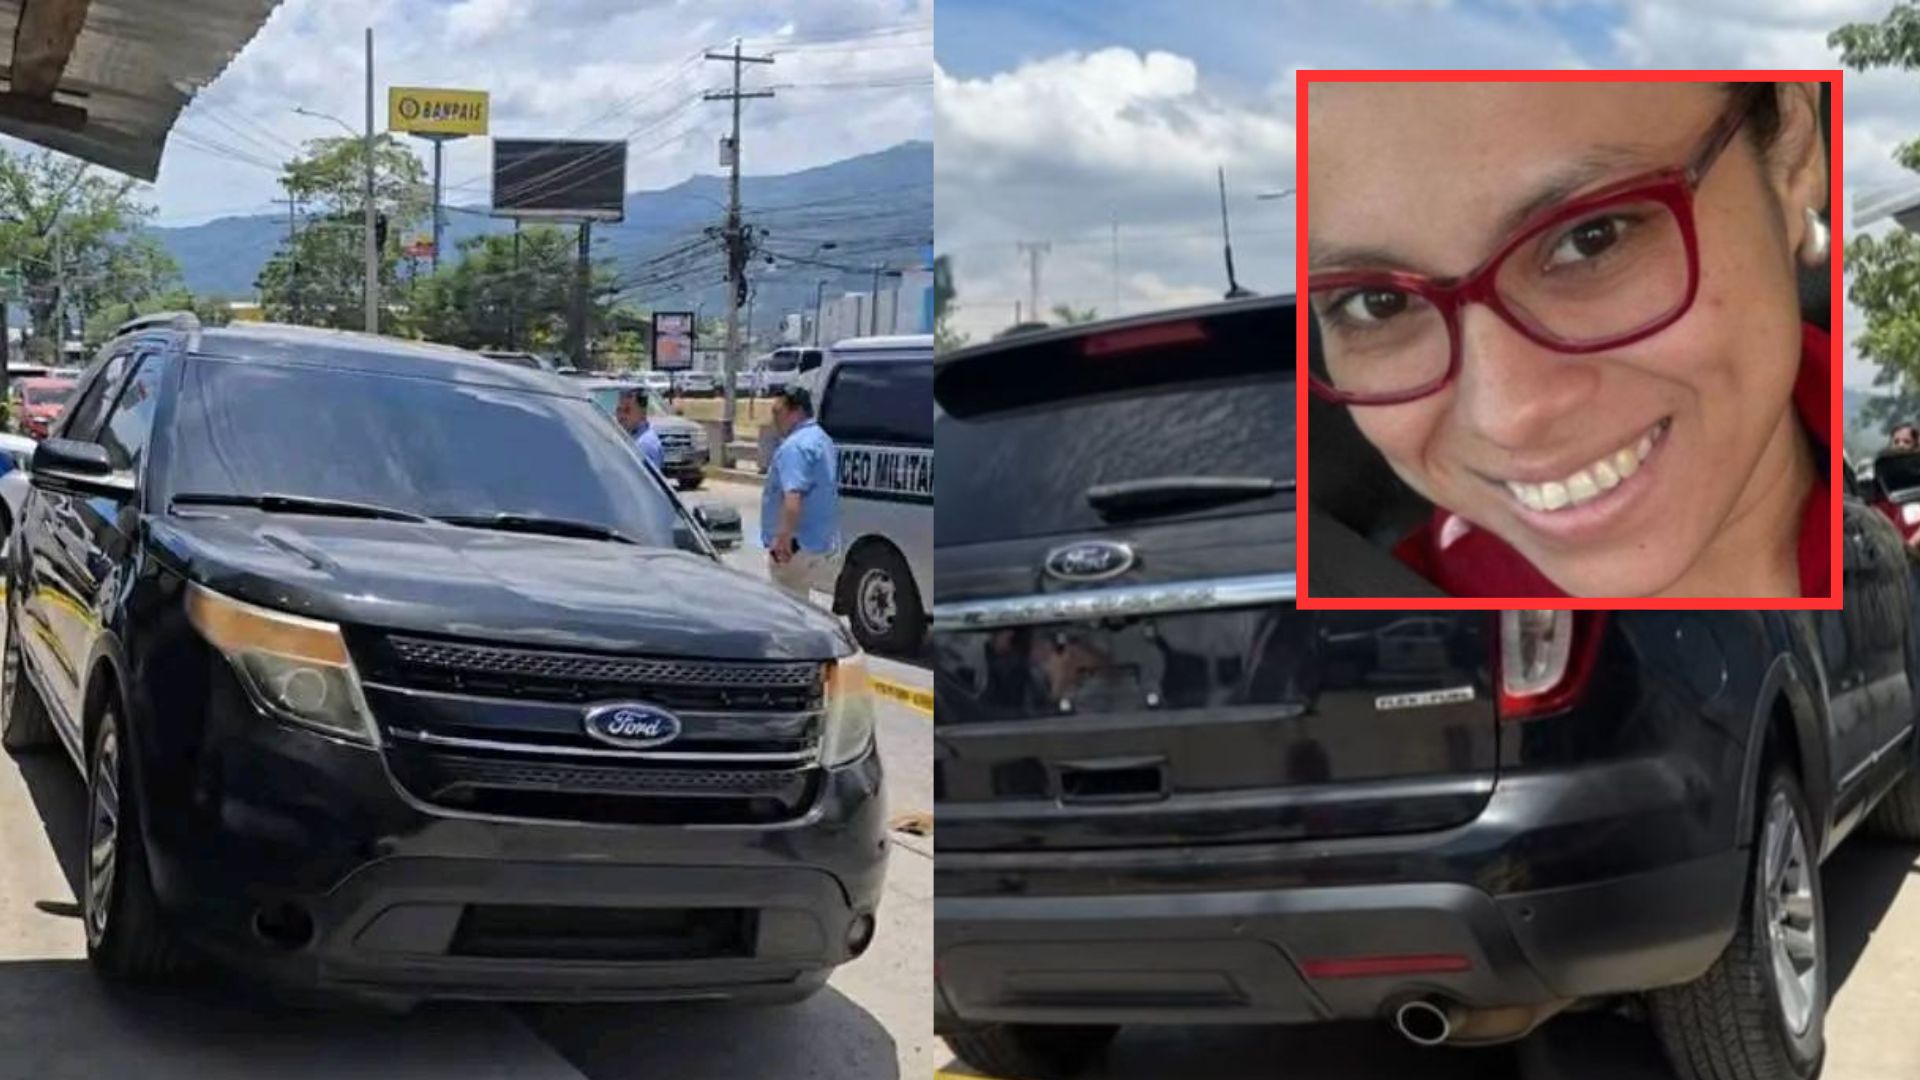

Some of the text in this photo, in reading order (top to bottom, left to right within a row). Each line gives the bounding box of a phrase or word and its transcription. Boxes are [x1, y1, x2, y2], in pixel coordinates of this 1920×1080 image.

[836, 450, 872, 488] ICEO
[1062, 547, 1111, 573] Ford
[607, 709, 661, 737] Ford
